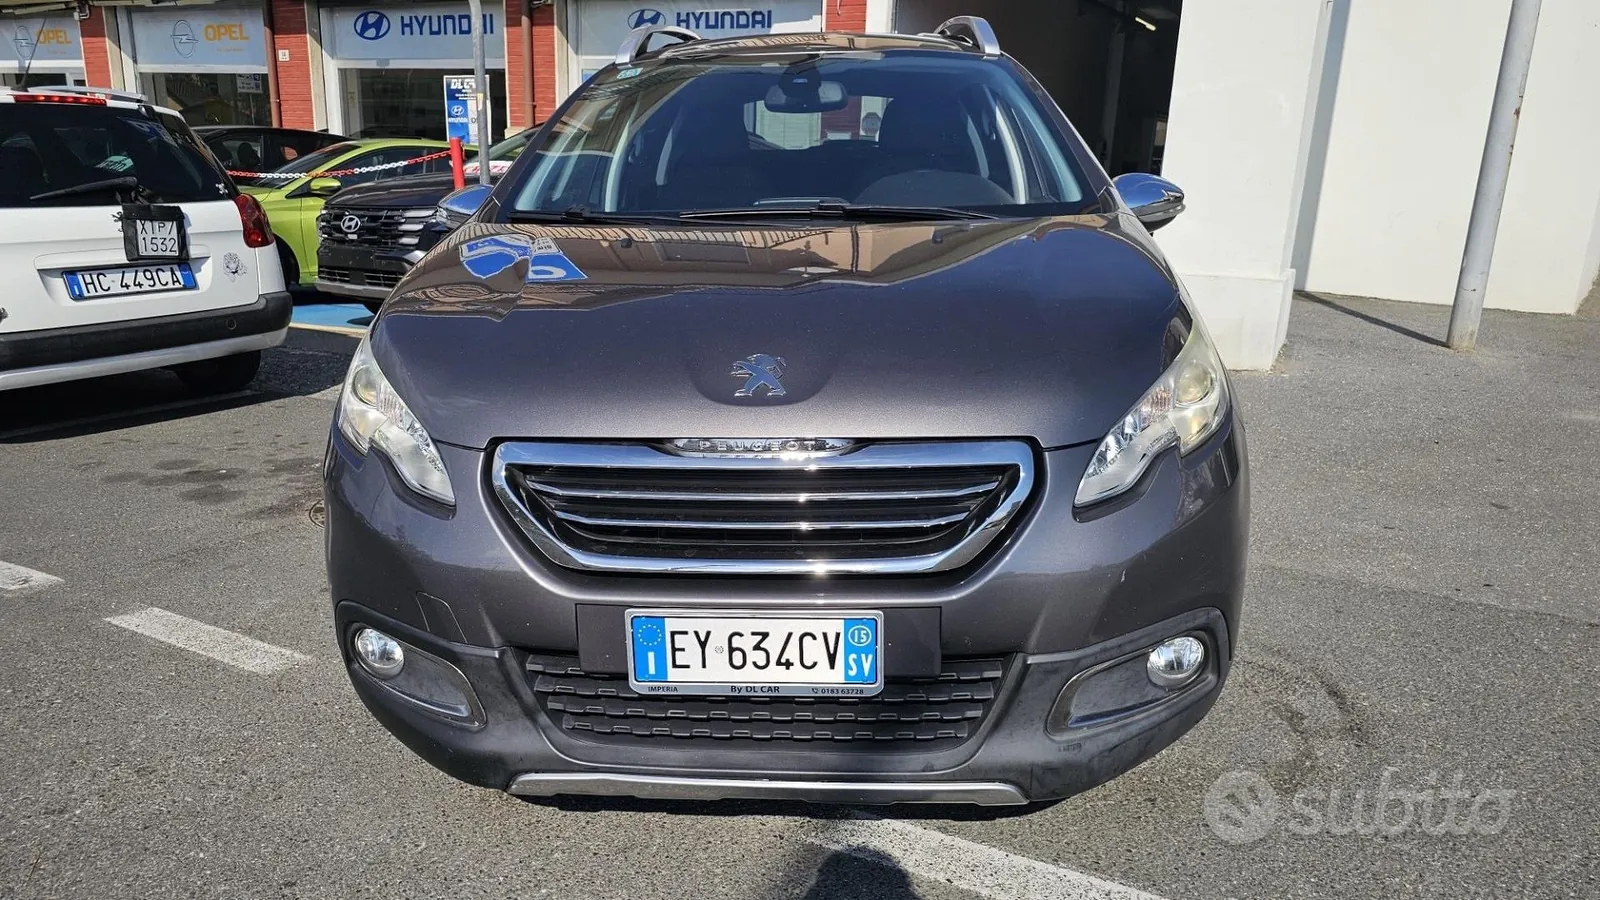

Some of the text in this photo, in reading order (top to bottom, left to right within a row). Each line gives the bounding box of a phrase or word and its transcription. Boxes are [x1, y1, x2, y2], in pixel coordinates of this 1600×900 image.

[400, 12, 494, 36] HYUNDI
[676, 9, 772, 30] HYUNDAI
[36, 28, 72, 45] OPEL
[204, 23, 249, 41] OPEL
[141, 237, 177, 253] 1532
[81, 272, 111, 293] HC
[119, 266, 182, 290] 449CA
[700, 440, 815, 451] PEUGEOT
[853, 628, 868, 641] 15
[669, 630, 712, 669] EY
[727, 631, 841, 670] 634CV
[848, 653, 873, 677] SV
[730, 685, 742, 694] By
[745, 685, 759, 693] DL
[760, 685, 780, 693] CAR
